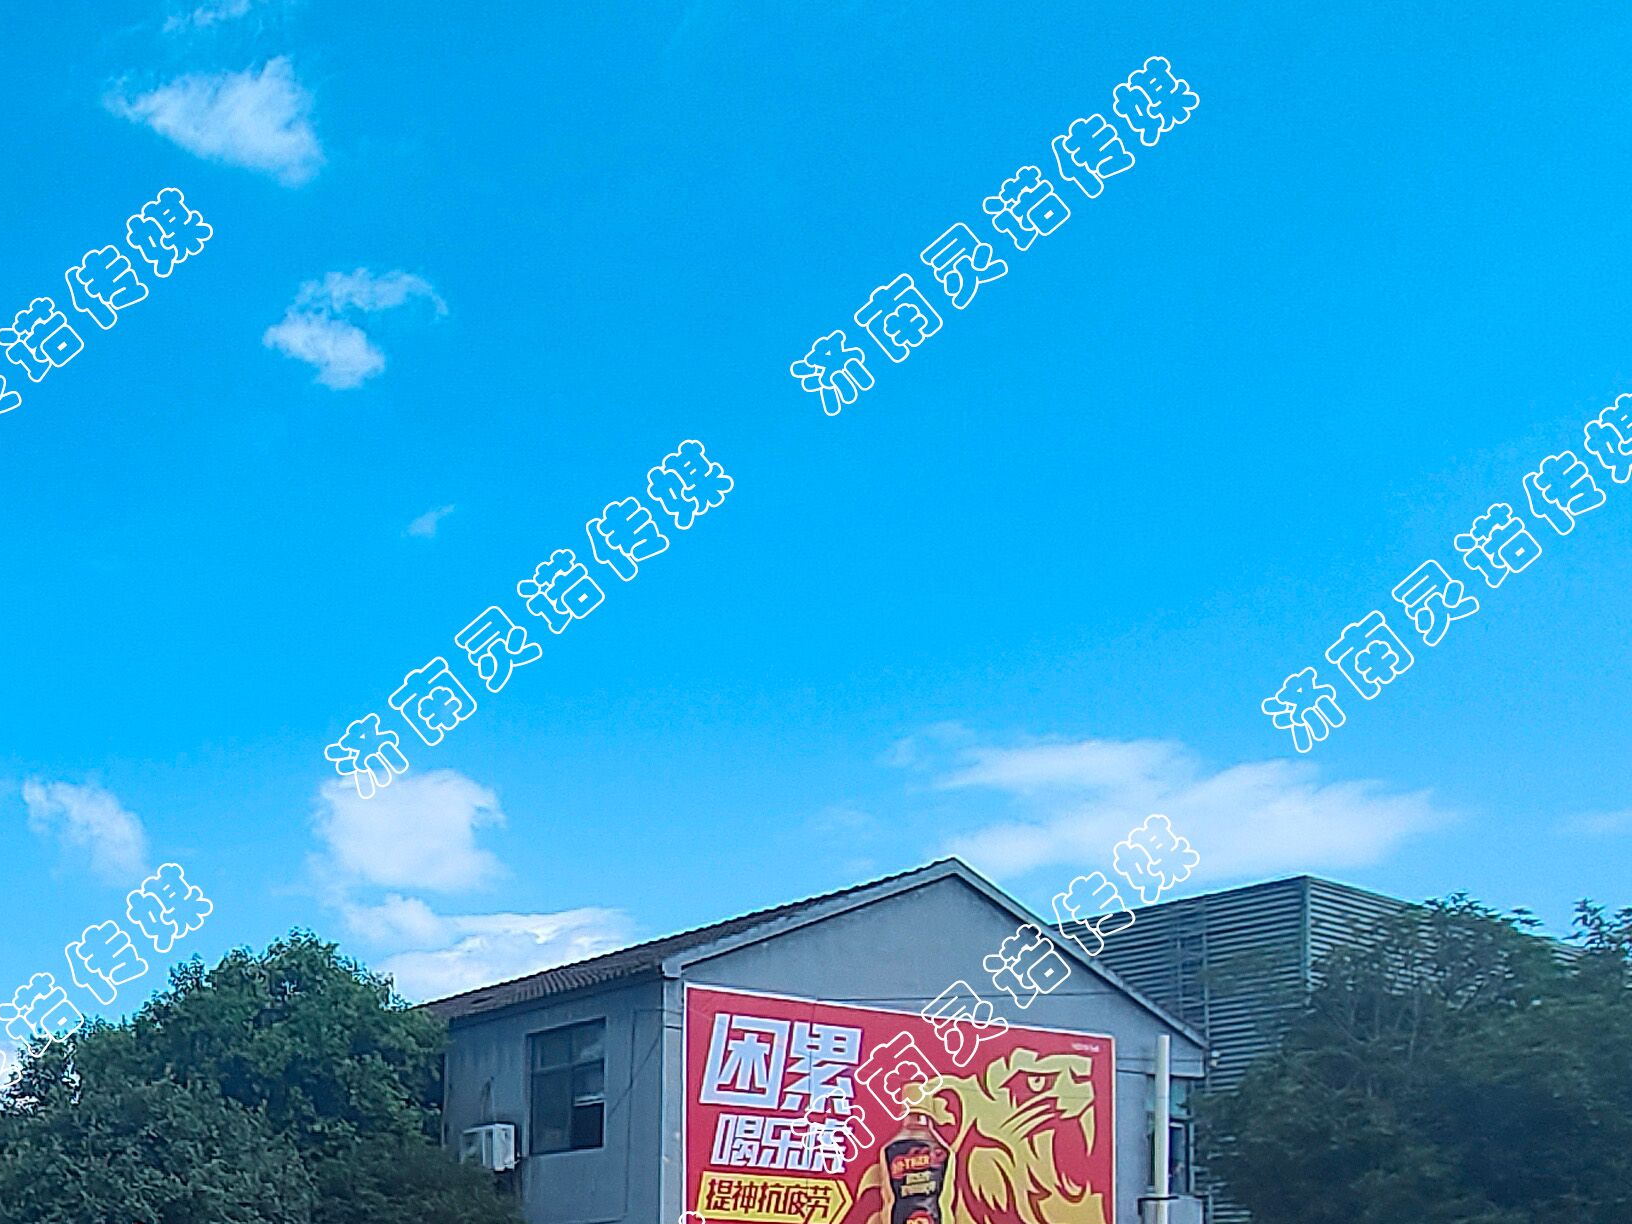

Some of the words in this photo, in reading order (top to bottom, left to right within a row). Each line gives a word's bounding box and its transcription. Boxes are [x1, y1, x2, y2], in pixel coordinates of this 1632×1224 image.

[699, 1013, 863, 1115] 困累
[710, 1112, 853, 1174] 喝乐虎
[705, 1178, 832, 1219] 提神抗疲劳
